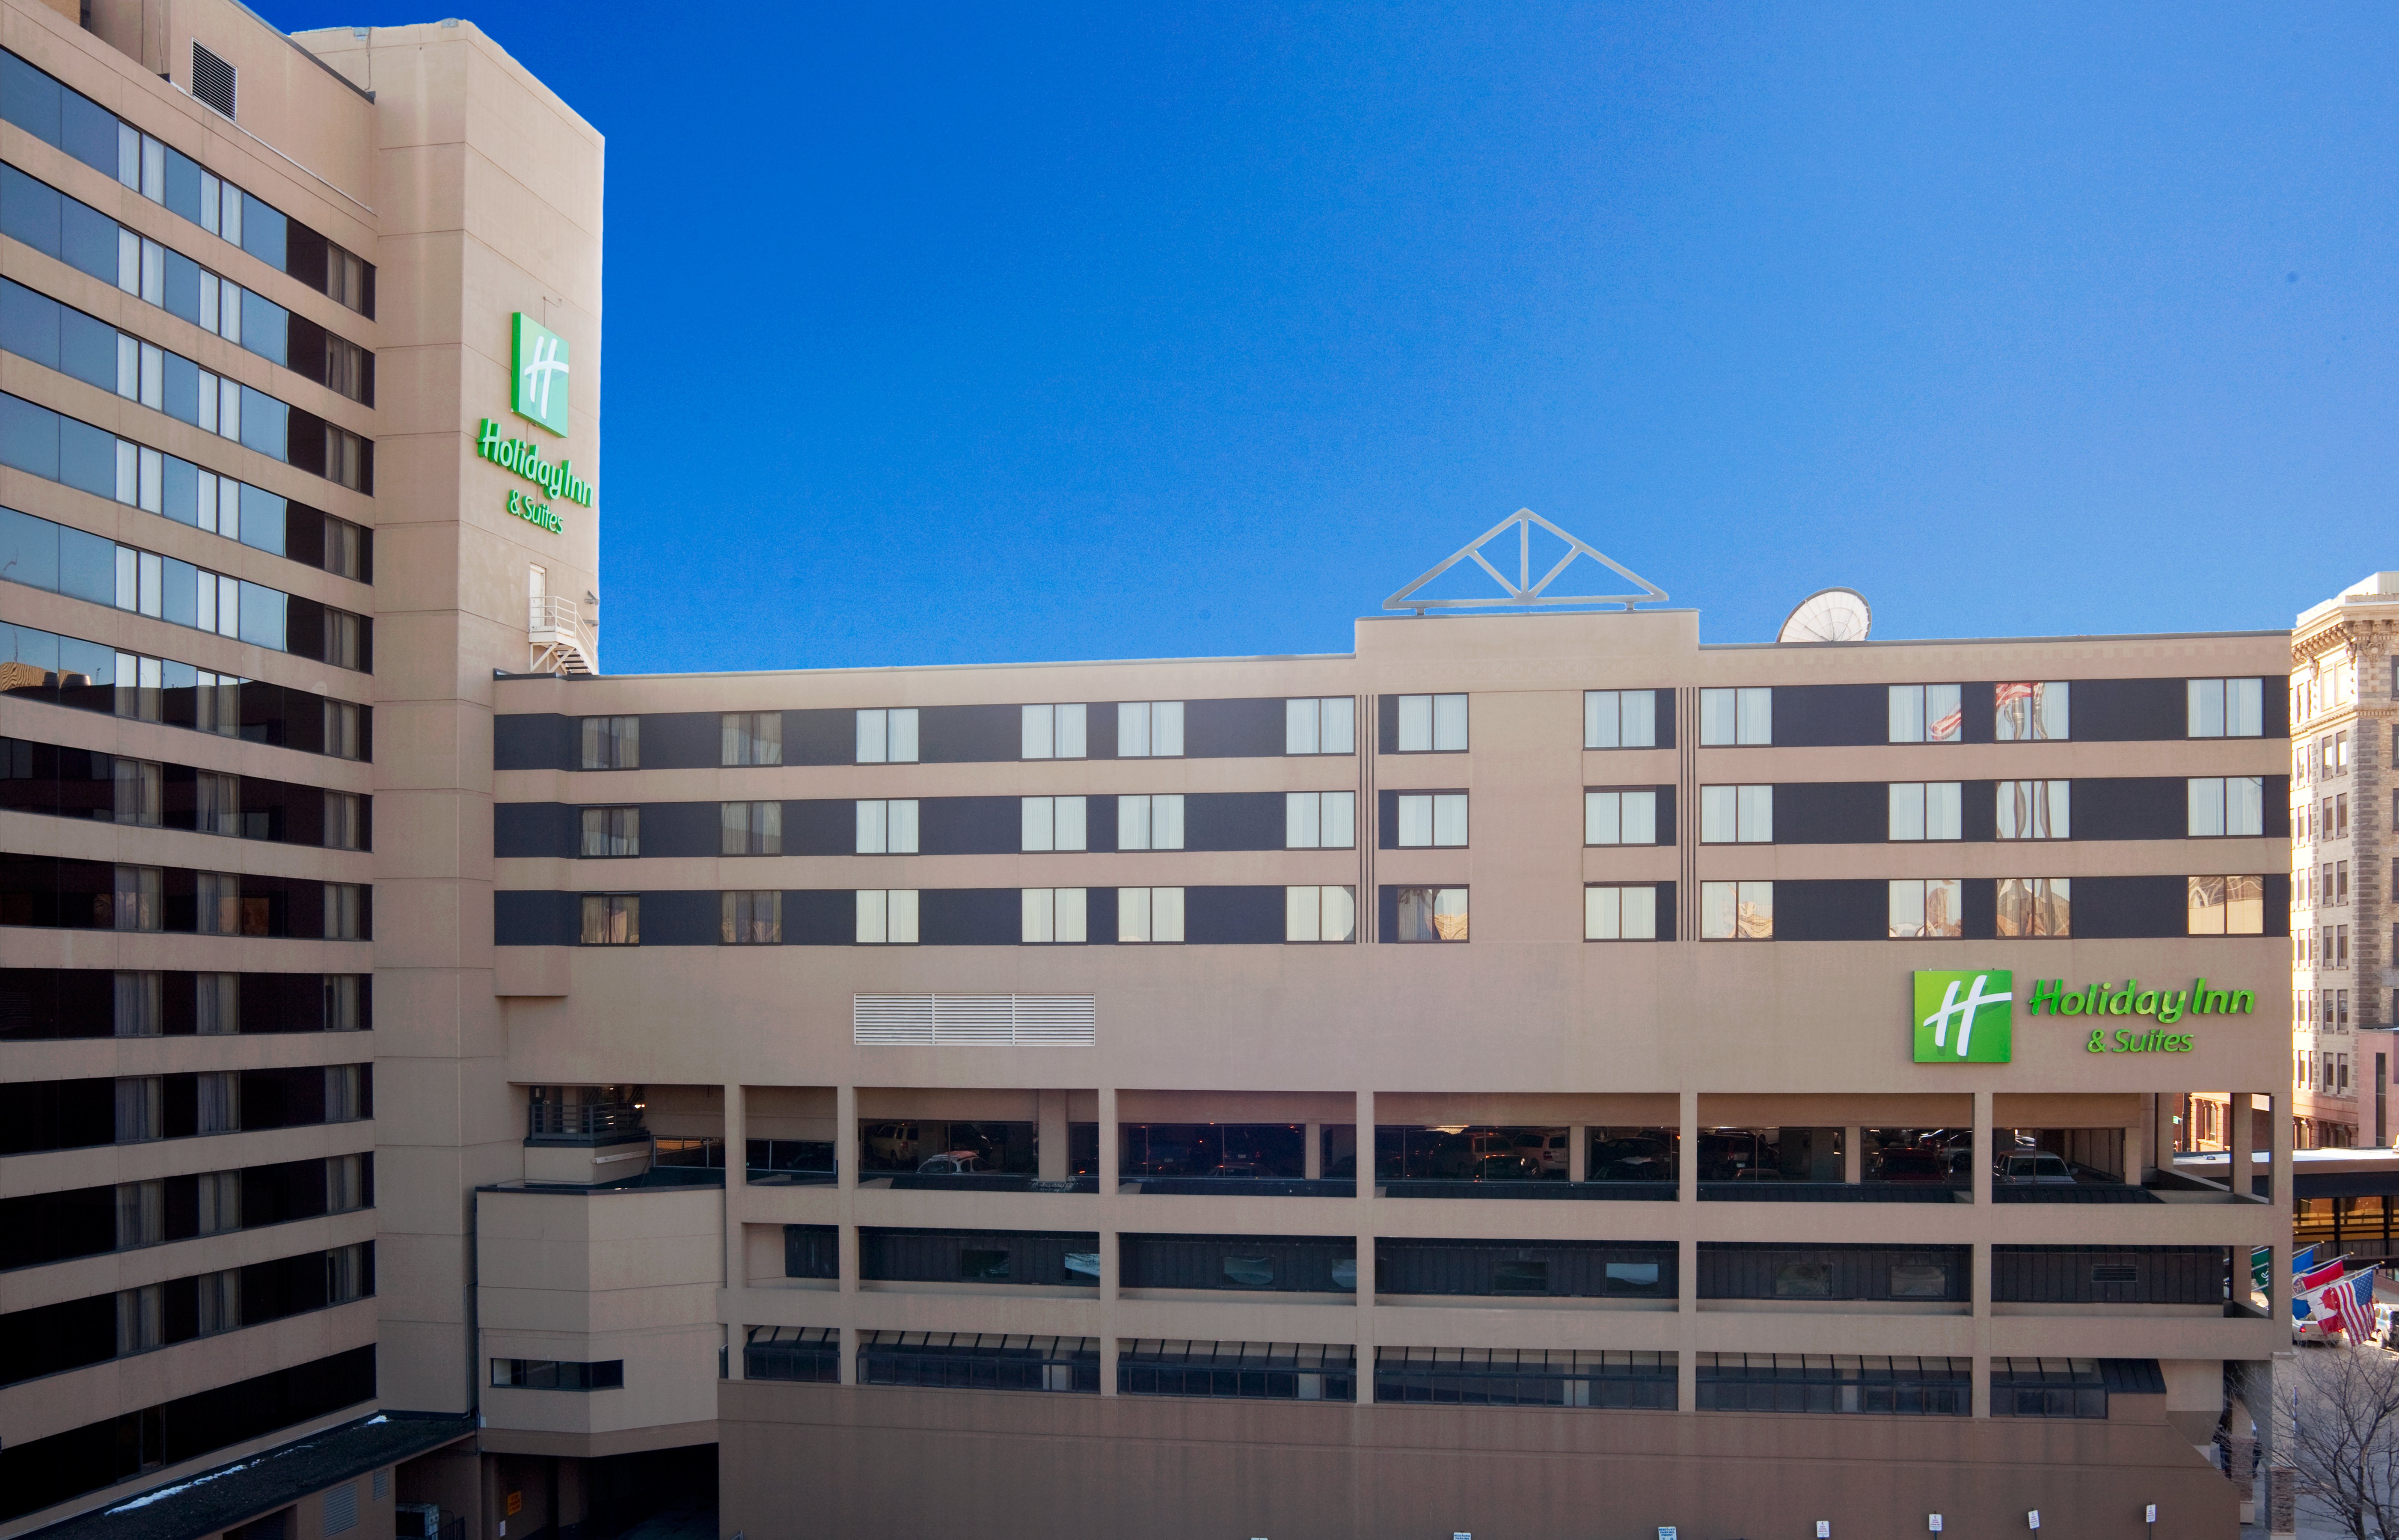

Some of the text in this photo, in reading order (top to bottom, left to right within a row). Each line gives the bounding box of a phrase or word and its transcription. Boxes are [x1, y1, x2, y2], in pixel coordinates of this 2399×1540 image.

[476, 418, 594, 507] Holiday Inn
[507, 490, 564, 535] & Suites
[2029, 978, 2255, 1024] Holiday Inn
[2088, 1029, 2194, 1053] & Suites
